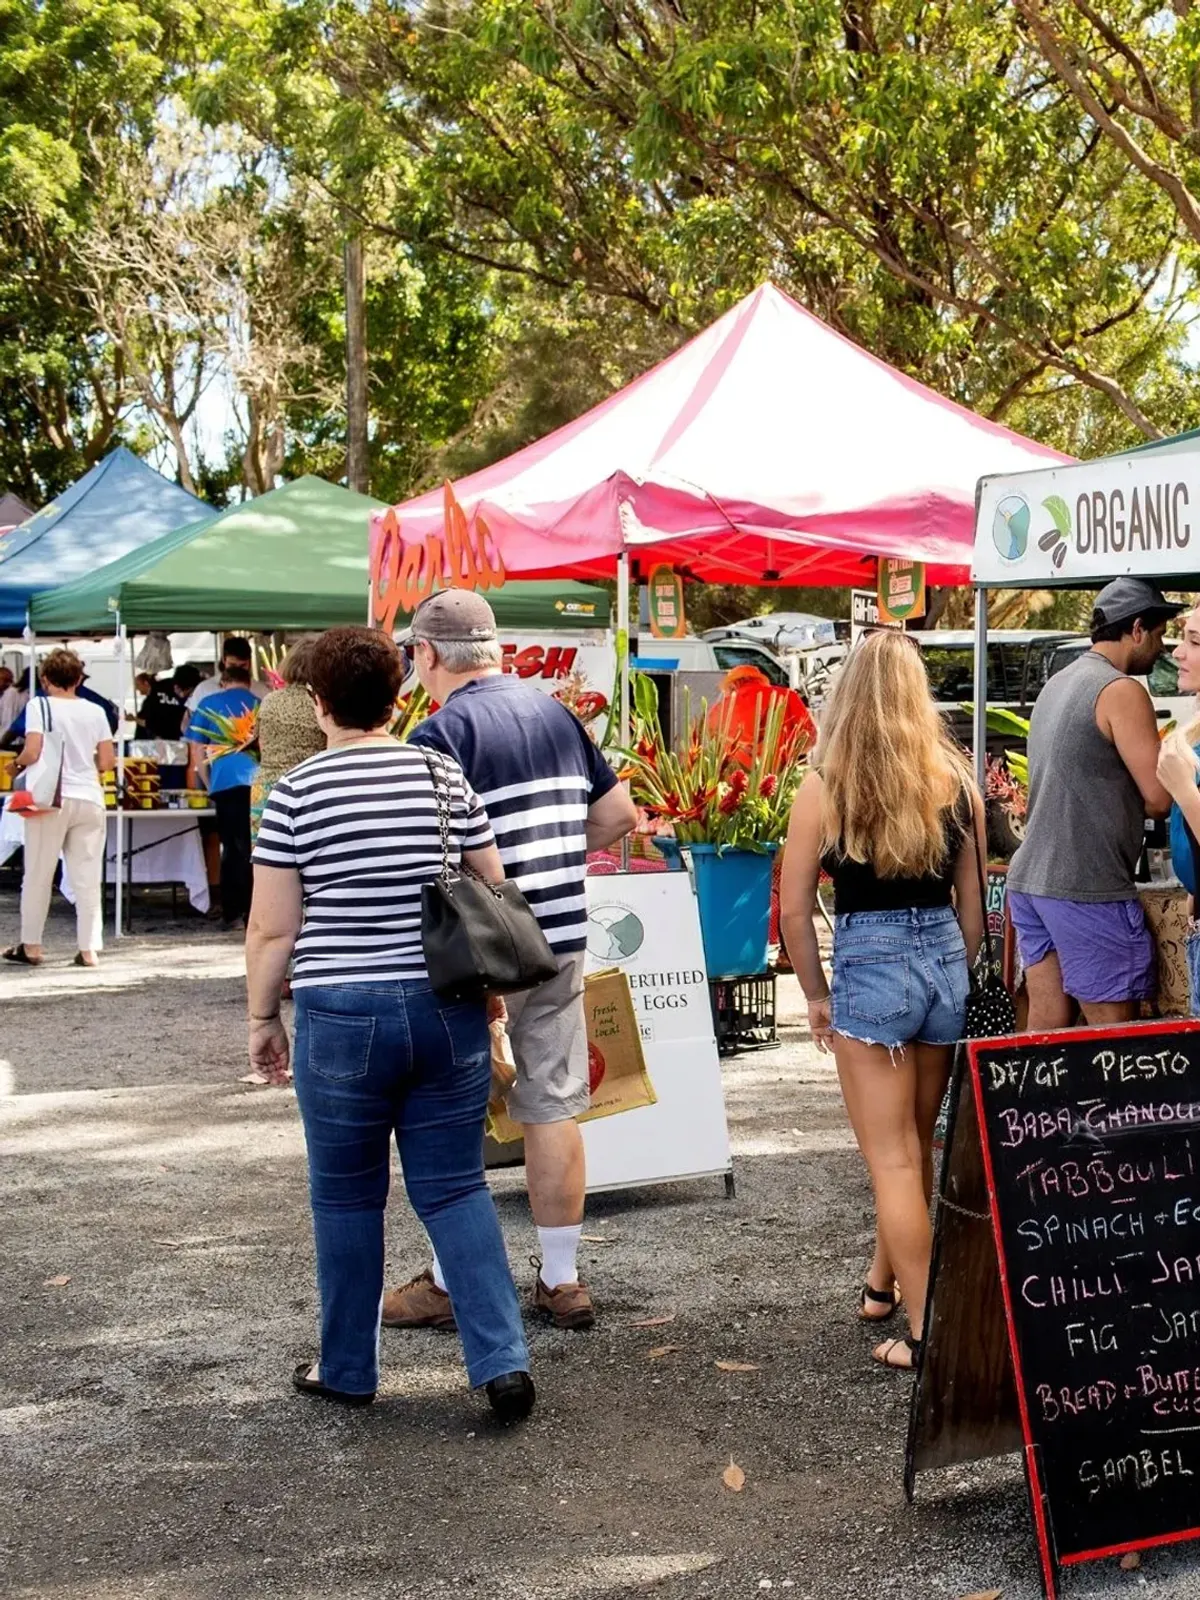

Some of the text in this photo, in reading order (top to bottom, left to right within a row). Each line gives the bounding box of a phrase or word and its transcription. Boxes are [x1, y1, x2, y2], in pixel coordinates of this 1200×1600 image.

[1075, 483, 1190, 554] ORGANIC
[500, 644, 577, 680] ESH
[630, 969, 705, 989] ERTIFIED
[592, 1003, 618, 1021] fresh
[644, 993, 689, 1012] EGGS
[988, 1049, 1190, 1097] DF/GF PESTO
[998, 1107, 1072, 1147] BABA
[1017, 1212, 1144, 1251] SPINACH
[1036, 1379, 1116, 1421] BREAD
[1079, 1449, 1194, 1494] SAMBEL
